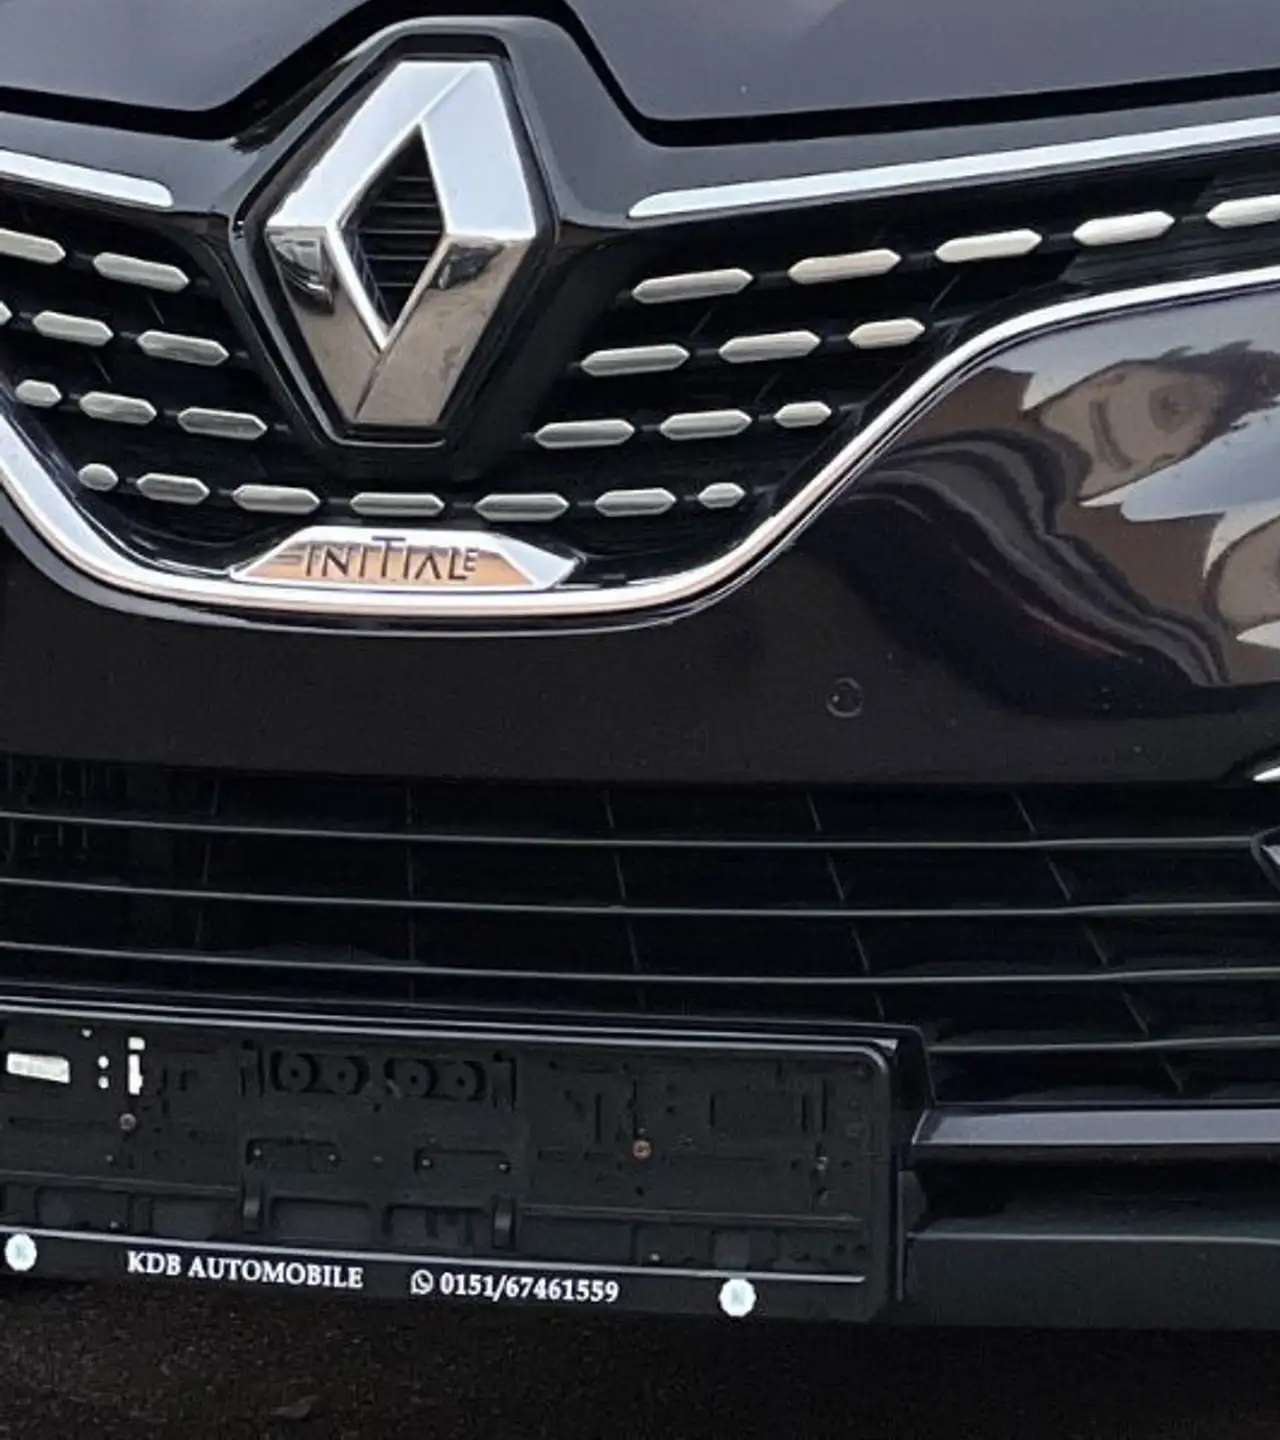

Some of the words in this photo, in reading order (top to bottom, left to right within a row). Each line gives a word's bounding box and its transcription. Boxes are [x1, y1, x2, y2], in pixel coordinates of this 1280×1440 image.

[305, 535, 480, 581] INITIALE
[126, 1250, 182, 1276] KDB
[187, 1255, 365, 1289] AUTOMOBILE
[438, 1270, 620, 1304] 0151/67461559
